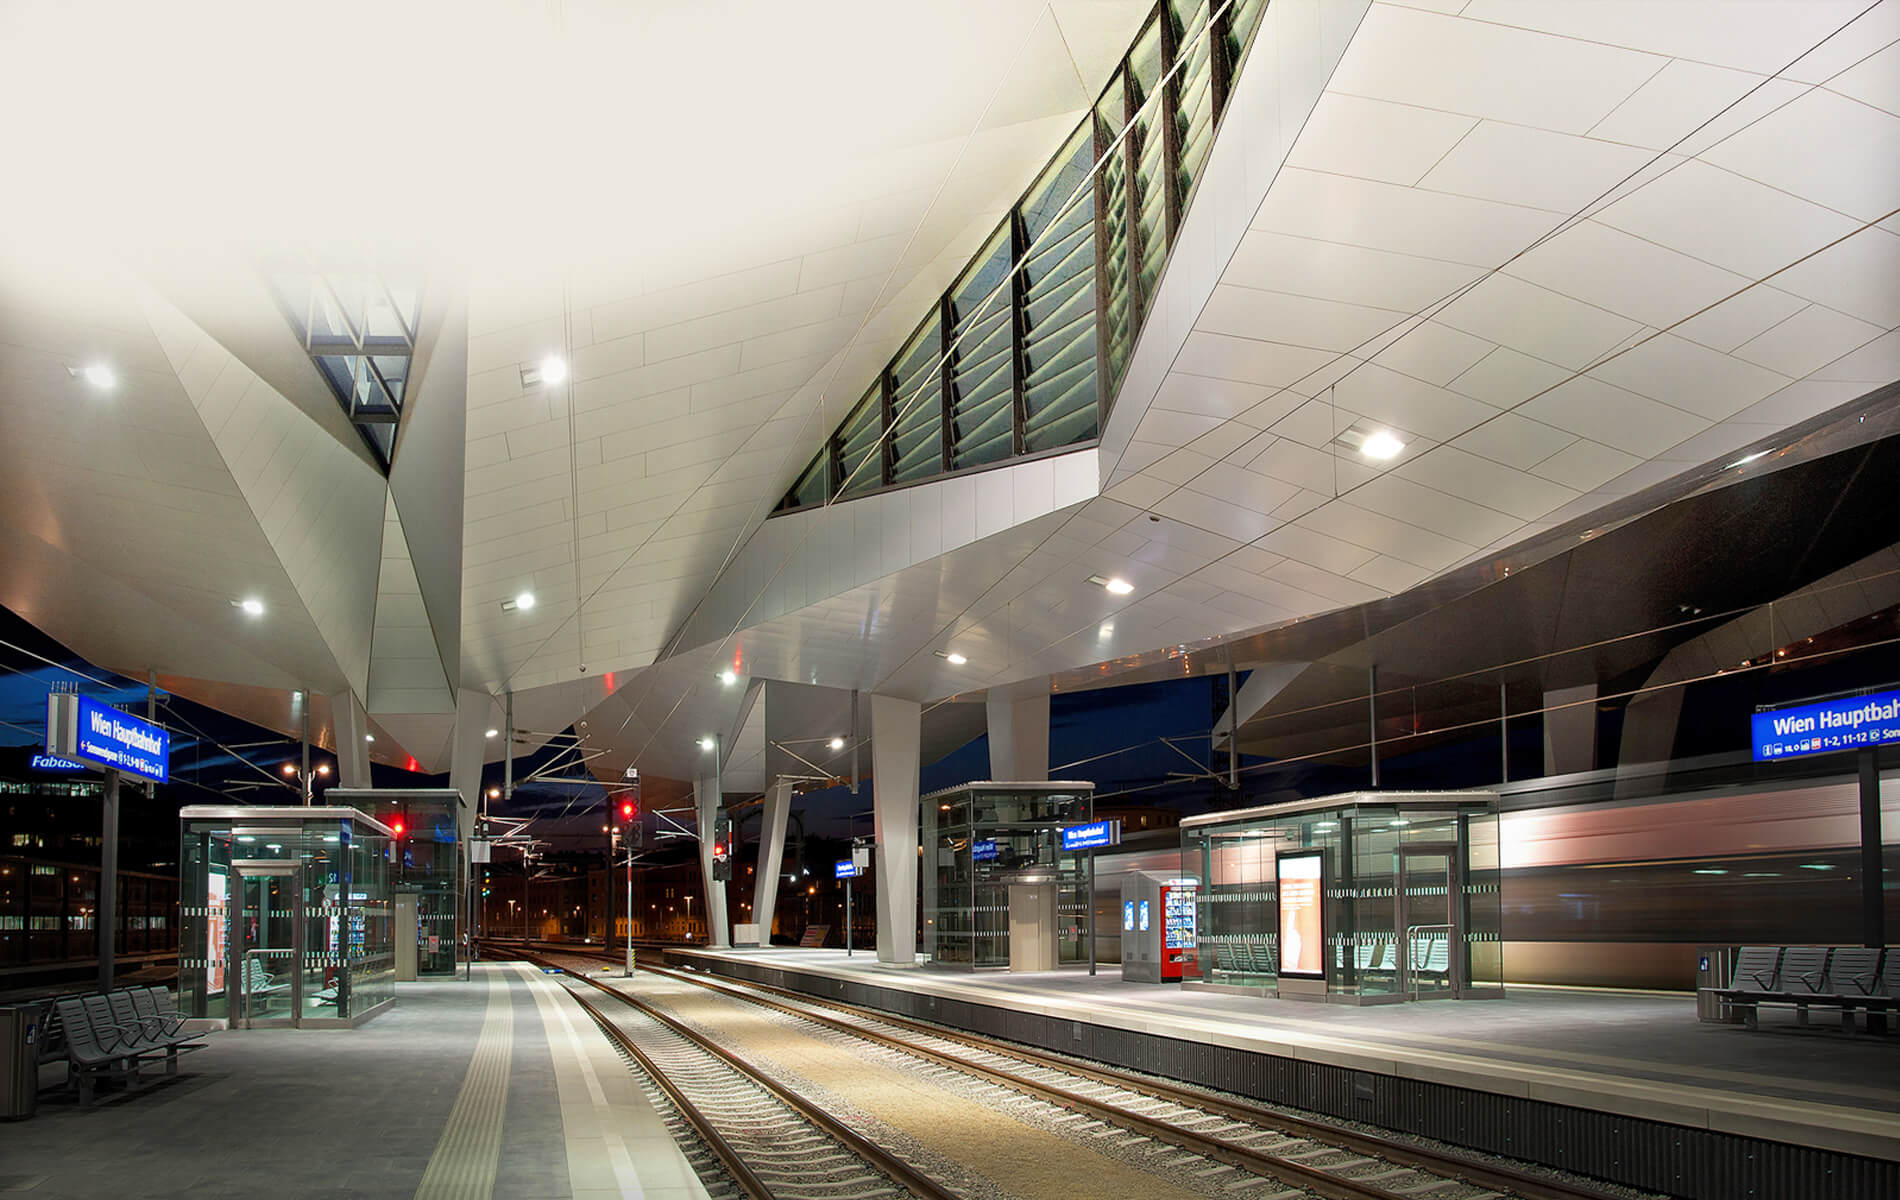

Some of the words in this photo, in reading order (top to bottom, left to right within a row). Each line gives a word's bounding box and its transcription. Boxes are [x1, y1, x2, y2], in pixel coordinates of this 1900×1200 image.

[90, 710, 112, 738] Wien
[113, 719, 162, 756] Hauptbahnhof
[1773, 715, 1815, 736] Wien
[1824, 735, 1841, 747] 1-2,
[1842, 731, 1867, 745] 11-12
